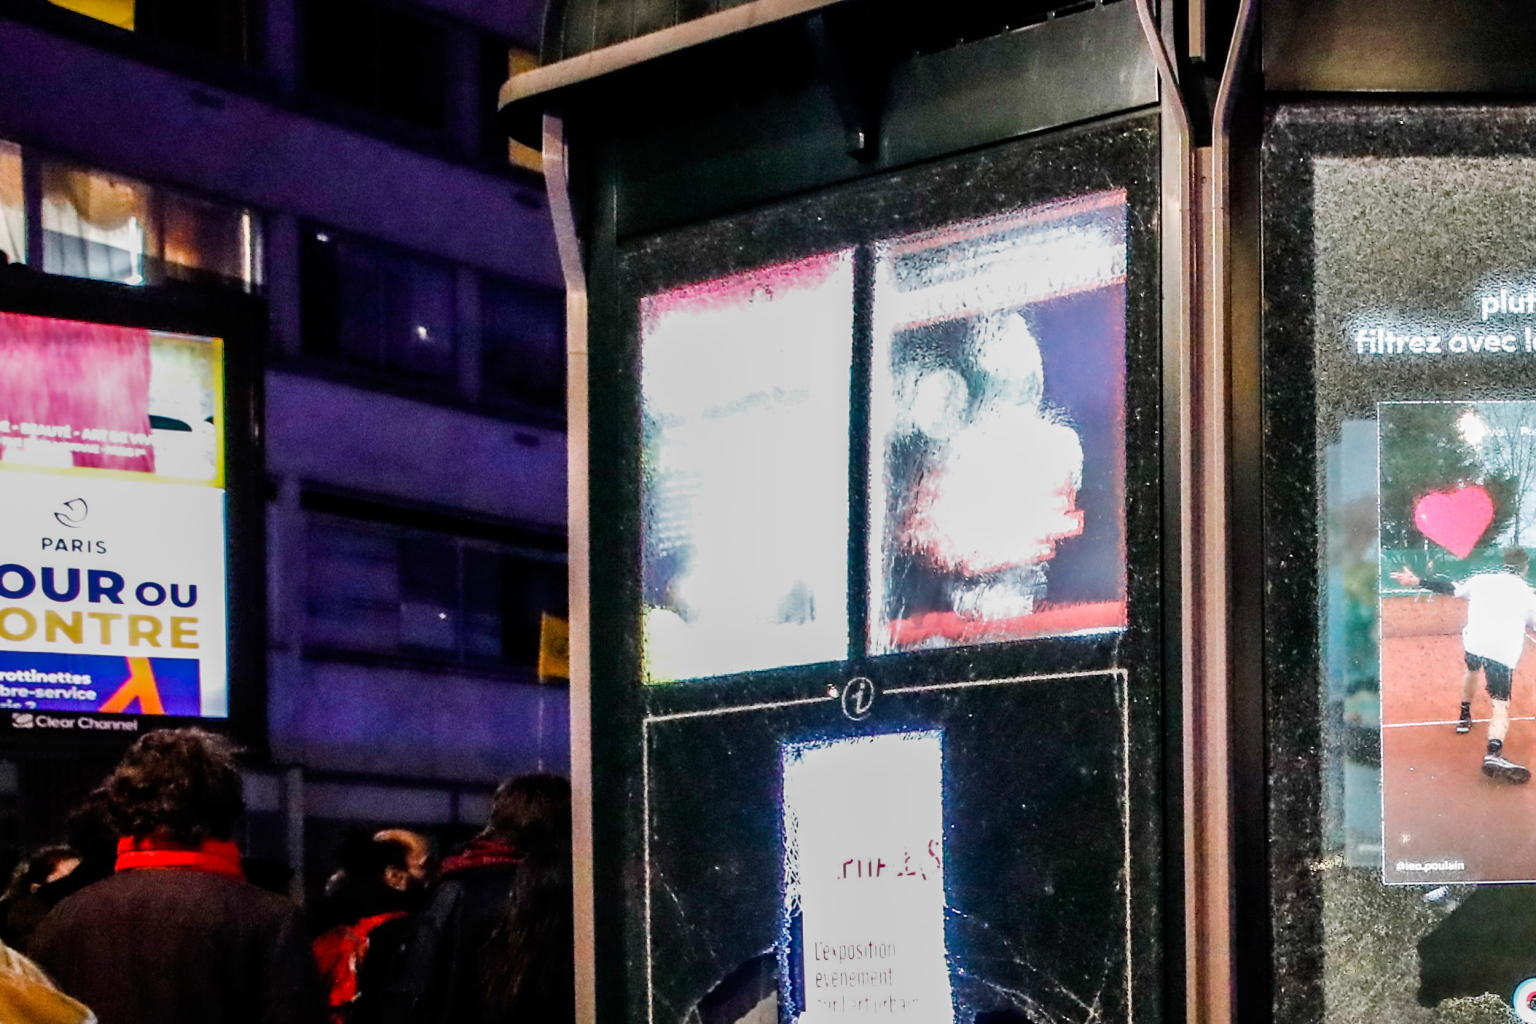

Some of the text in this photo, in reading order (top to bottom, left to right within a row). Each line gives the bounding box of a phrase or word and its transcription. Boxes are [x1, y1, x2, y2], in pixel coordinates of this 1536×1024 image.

[1354, 327, 1442, 354] filtrez
[1449, 332, 1517, 353] avec
[41, 537, 107, 554] PARIS
[135, 581, 197, 608] OU
[36, 715, 138, 731] Clear Channel
